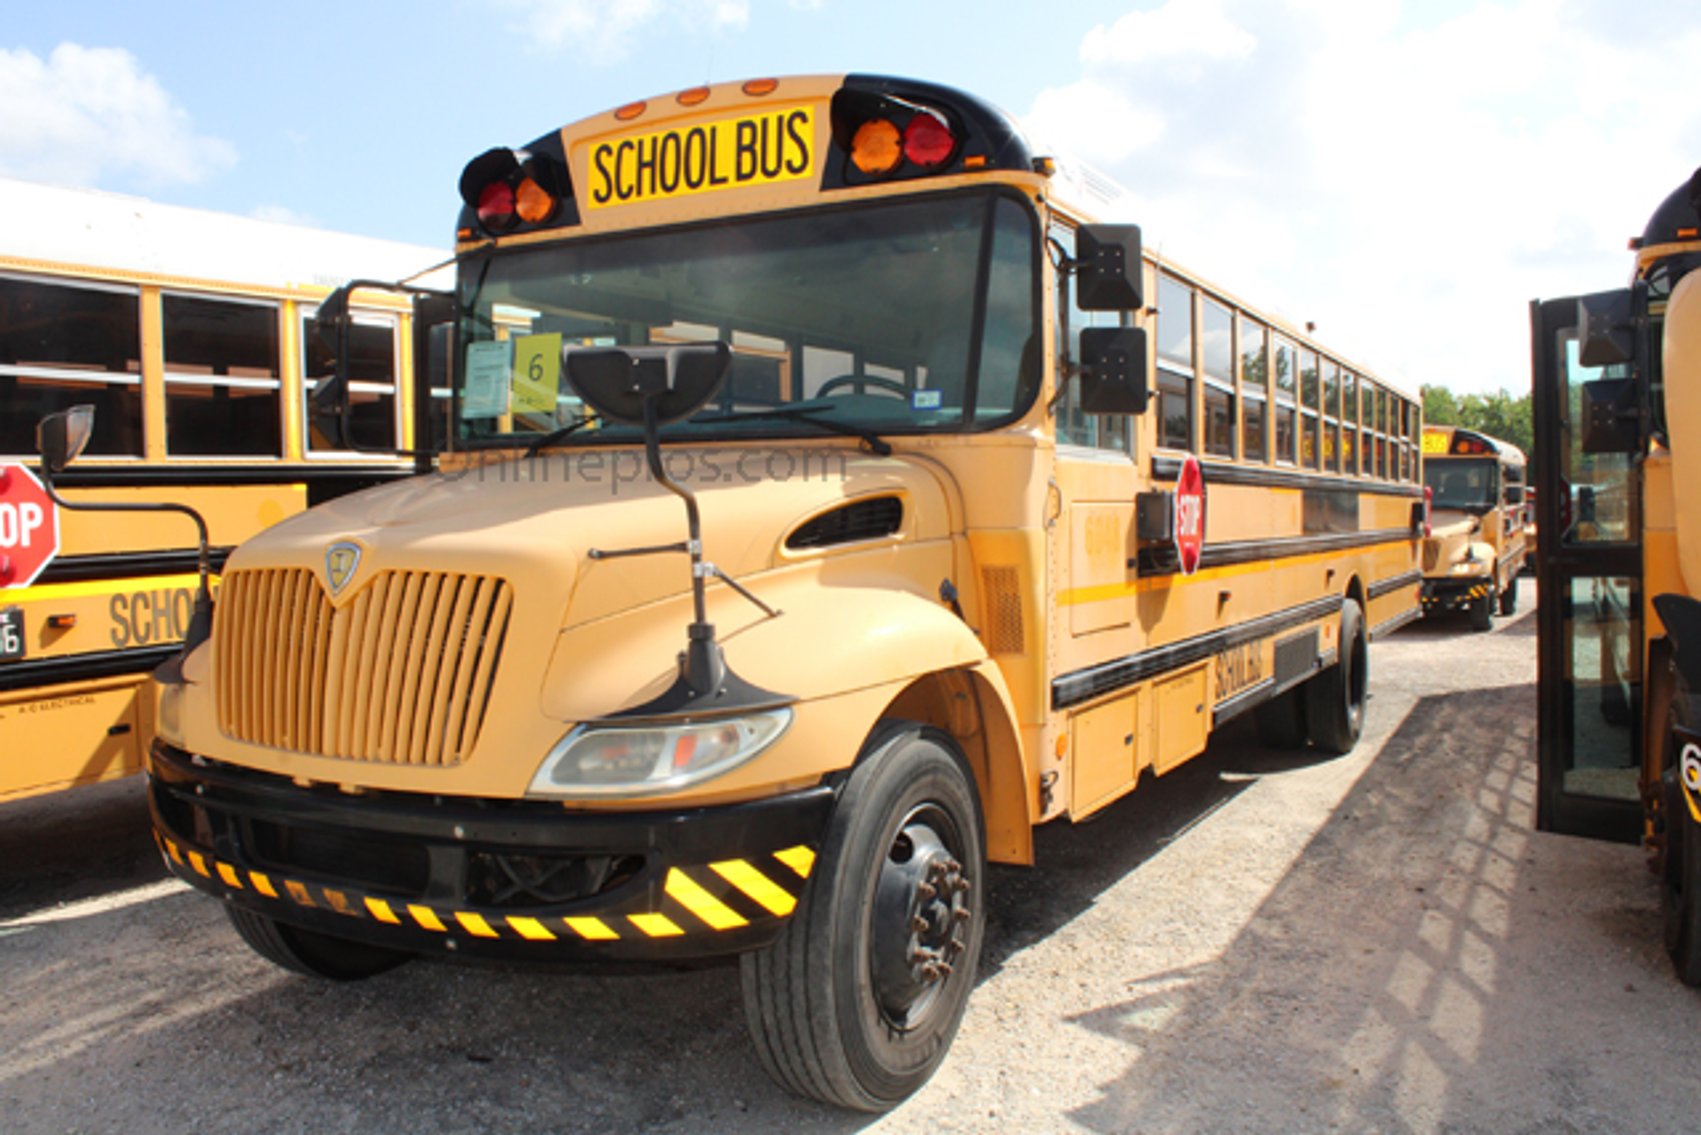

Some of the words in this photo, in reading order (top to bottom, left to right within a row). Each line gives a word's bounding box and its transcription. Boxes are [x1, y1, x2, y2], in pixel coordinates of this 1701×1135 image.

[593, 127, 729, 204] SCHOOL
[736, 110, 809, 182] BUS
[529, 352, 544, 382] 6
[0, 502, 44, 547] OP
[1180, 494, 1200, 535] STOP
[0, 624, 20, 653] 6
[109, 585, 219, 649] SCHO
